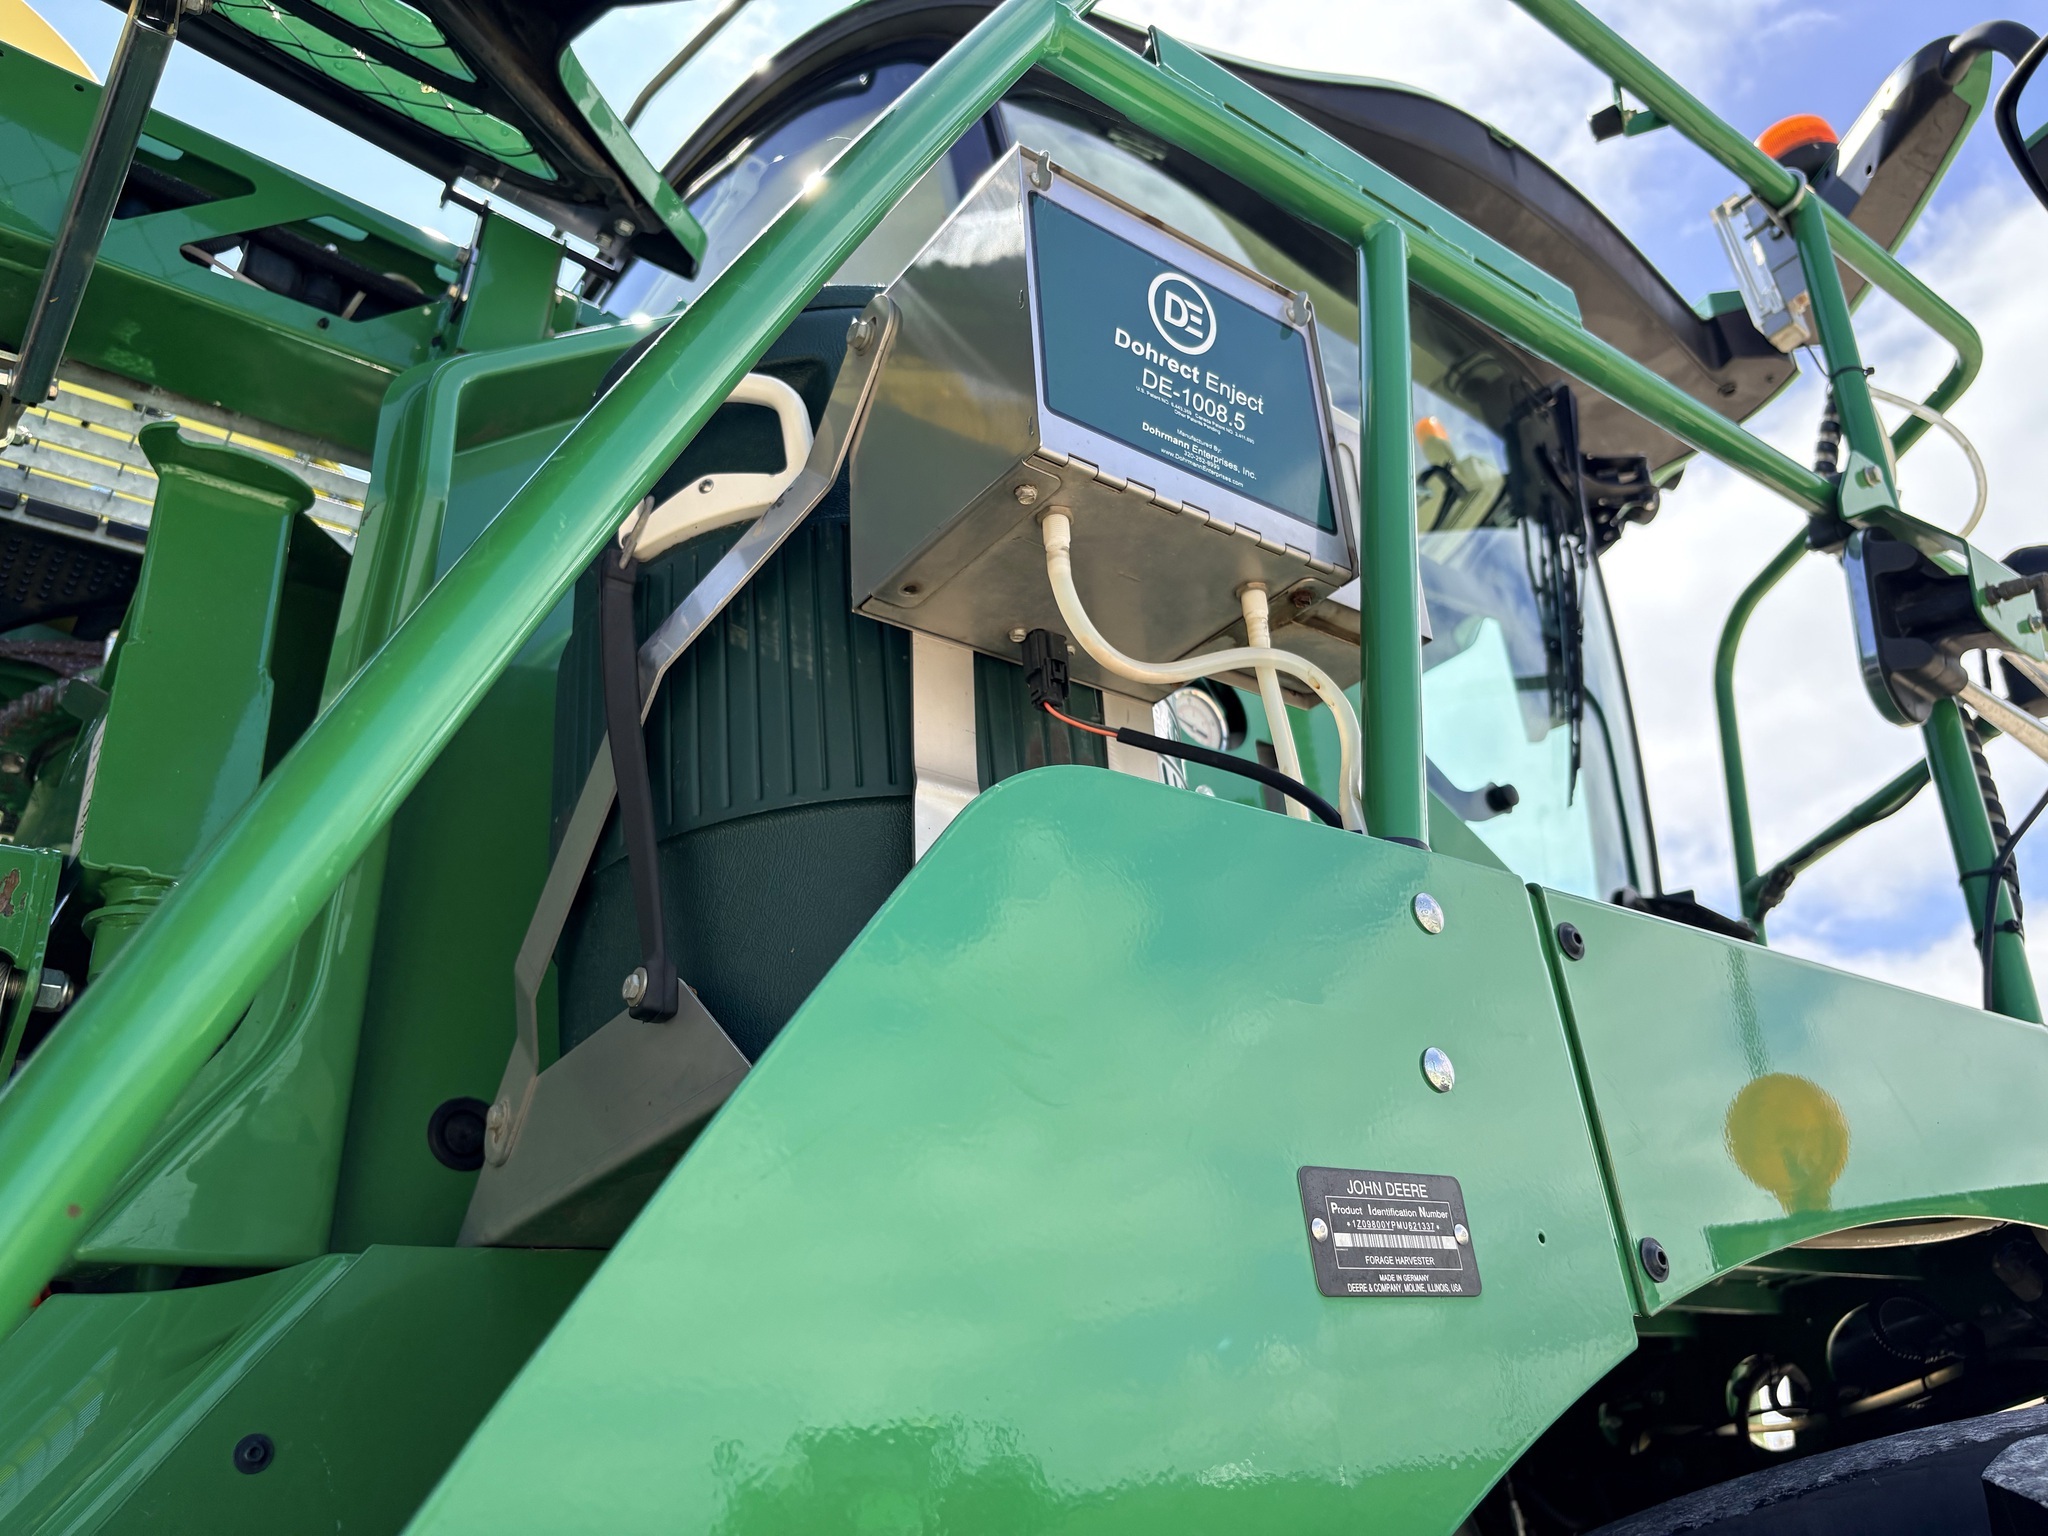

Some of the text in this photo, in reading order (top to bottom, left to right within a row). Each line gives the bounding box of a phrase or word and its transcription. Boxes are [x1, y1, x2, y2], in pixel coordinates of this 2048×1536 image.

[1114, 327, 1264, 415] Dohrect Enject
[1142, 367, 1246, 431] DE-1008.5
[1203, 422, 1221, 436] Pending
[1176, 428, 1222, 454] Manufactured By:
[1142, 422, 1190, 450] Dohrmann
[1242, 466, 1257, 480] Inc.
[1160, 447, 1244, 488] www.DohrmannEnterprises.com
[1346, 1179, 1429, 1198] JOHN DEERE
[1330, 1201, 1448, 1219] Product Identification Number
[1364, 1255, 1435, 1266] FORAGE HARVESTER
[1378, 1273, 1429, 1282] MADE IN GERMANY
[1347, 1283, 1463, 1294] DEERE & COMPANY, MOLINE, ILLINOIS, USA
